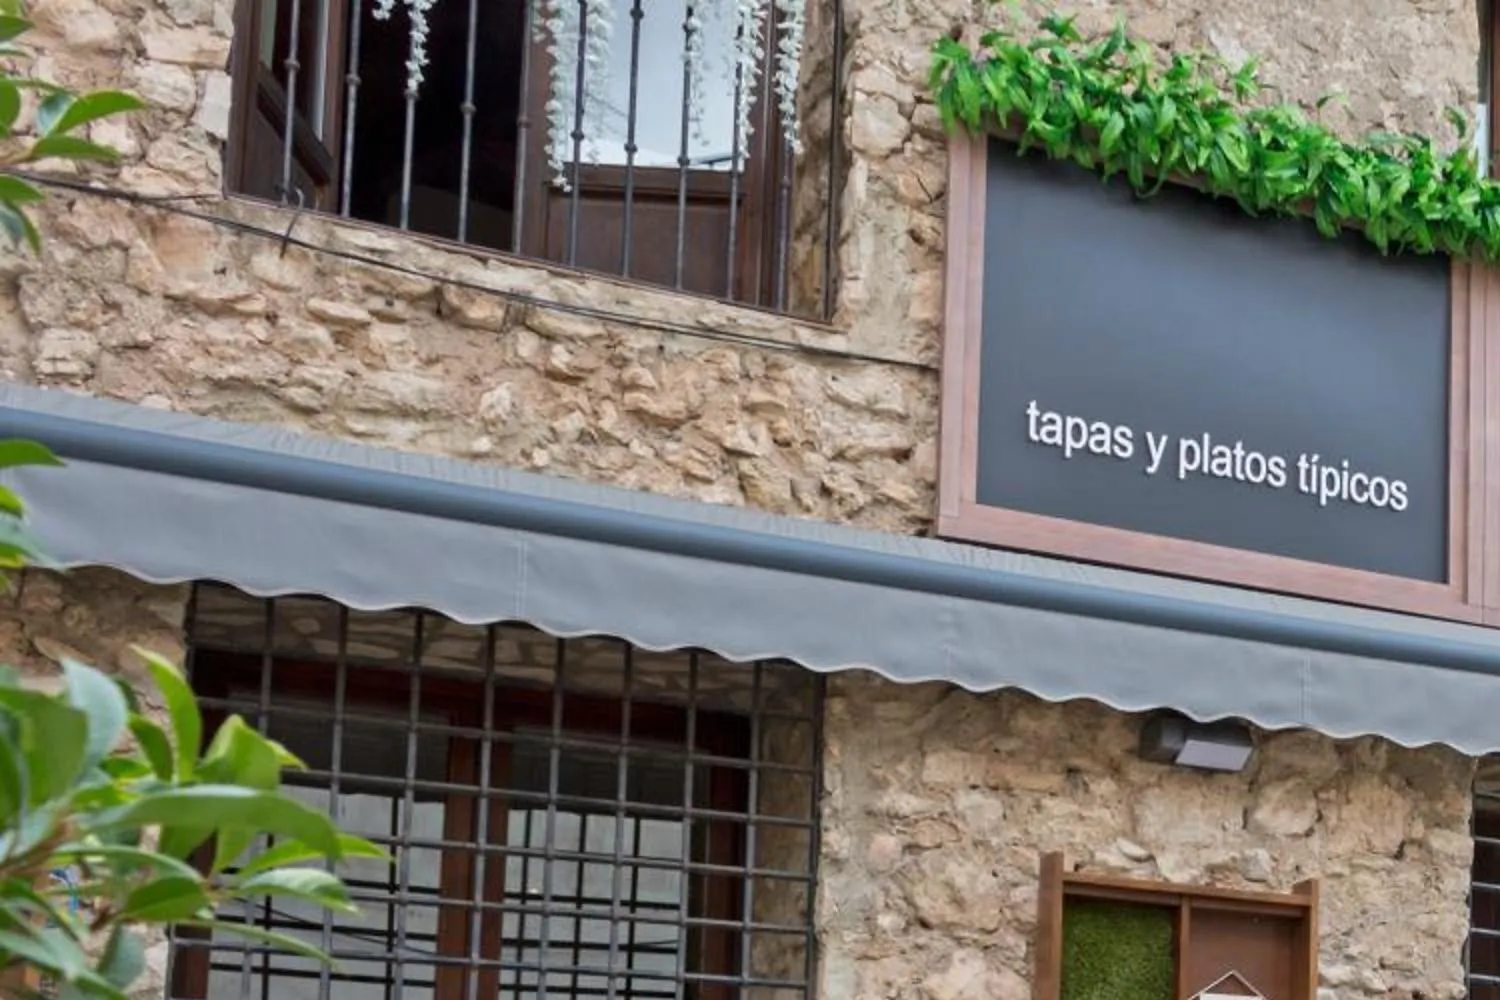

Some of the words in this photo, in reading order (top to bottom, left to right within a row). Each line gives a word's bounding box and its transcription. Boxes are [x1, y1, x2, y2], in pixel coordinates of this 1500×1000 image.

[1026, 399, 1134, 459] tapas
[1146, 430, 1168, 475] y
[1178, 432, 1288, 488] platos
[1296, 453, 1409, 511] típicos
